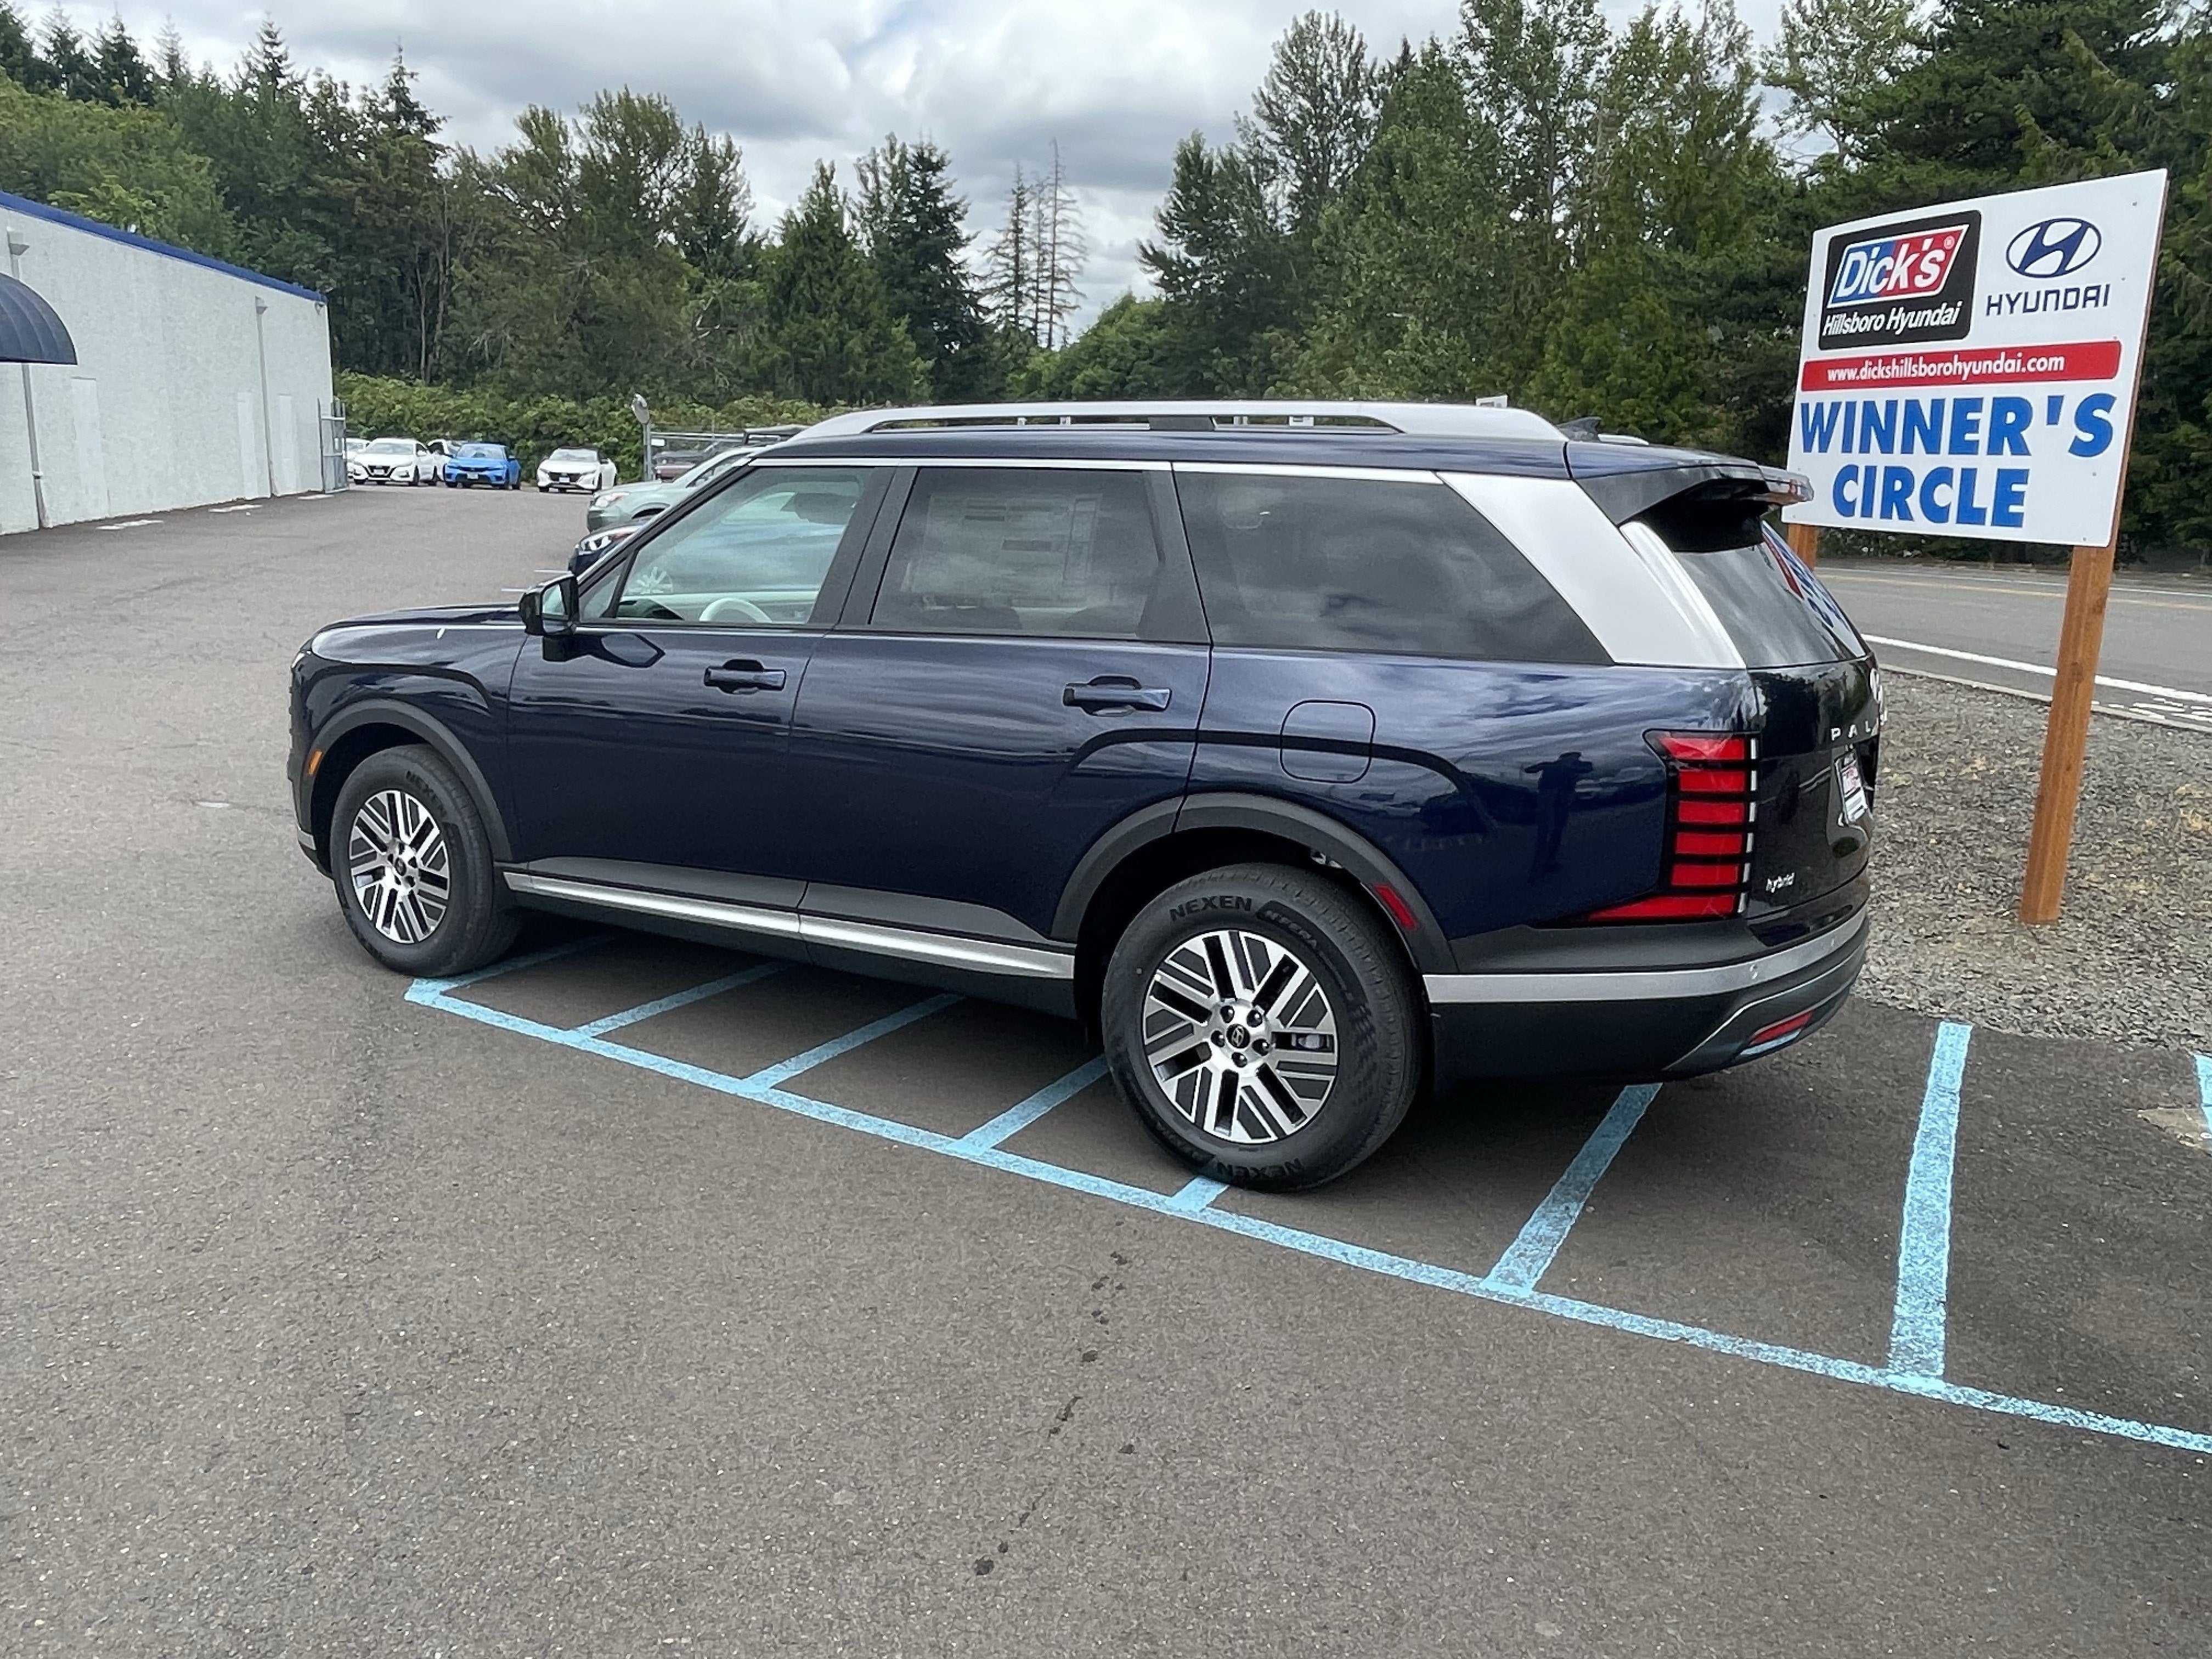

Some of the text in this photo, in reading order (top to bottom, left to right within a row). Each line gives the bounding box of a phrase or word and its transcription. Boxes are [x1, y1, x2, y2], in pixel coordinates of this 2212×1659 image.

[1836, 238, 1945, 297] Dick's
[1985, 284, 2111, 317] HYUNDAI
[1822, 301, 1963, 336] Hillsboro Hyundai
[1827, 352, 2064, 382] www.dickshillsborohyundai.com
[1800, 393, 2117, 458] WINNER'S
[1832, 464, 2030, 528] CIRCLE
[1766, 872, 1795, 893] hybrid
[1169, 895, 1252, 922] NEXEN
